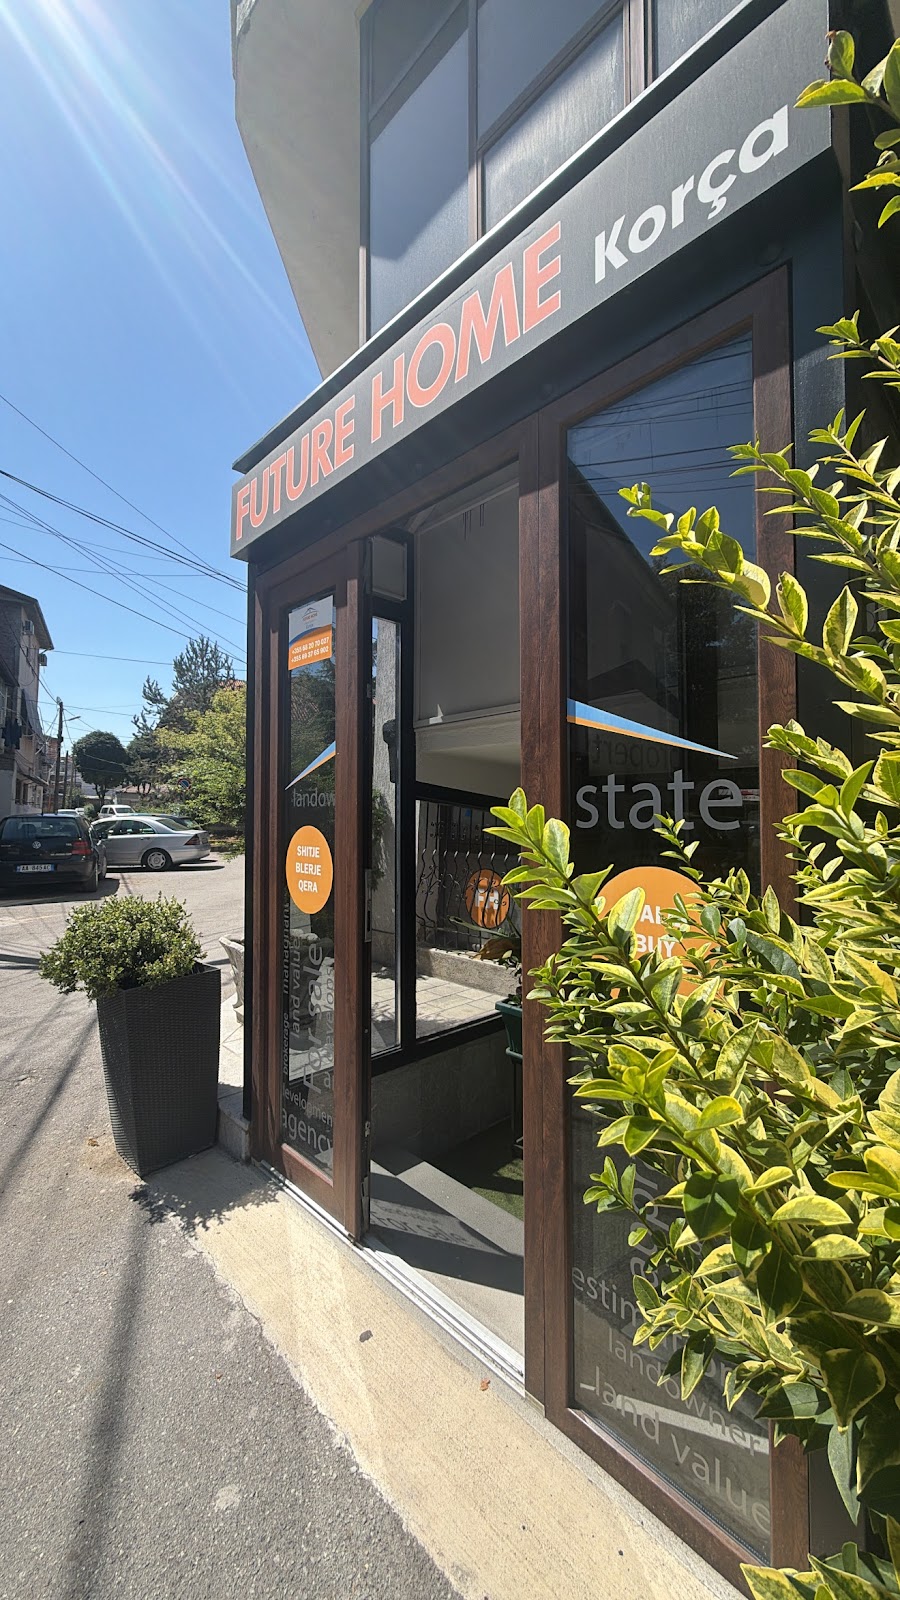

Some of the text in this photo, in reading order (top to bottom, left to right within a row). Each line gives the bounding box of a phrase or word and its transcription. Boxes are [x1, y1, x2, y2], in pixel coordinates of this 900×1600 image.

[236, 104, 789, 541] FUTURE HOME Korça
[576, 769, 743, 831] state
[295, 862, 321, 876] BLERJE
[297, 845, 320, 858] SHITJE
[298, 880, 318, 893] QERA
[636, 933, 676, 958] BUY
[290, 938, 301, 1039] land value
[303, 943, 322, 1094] For sale
[282, 1012, 290, 1075] brokerage
[608, 1328, 761, 1456] landowner
[595, 1366, 770, 1534] land value
